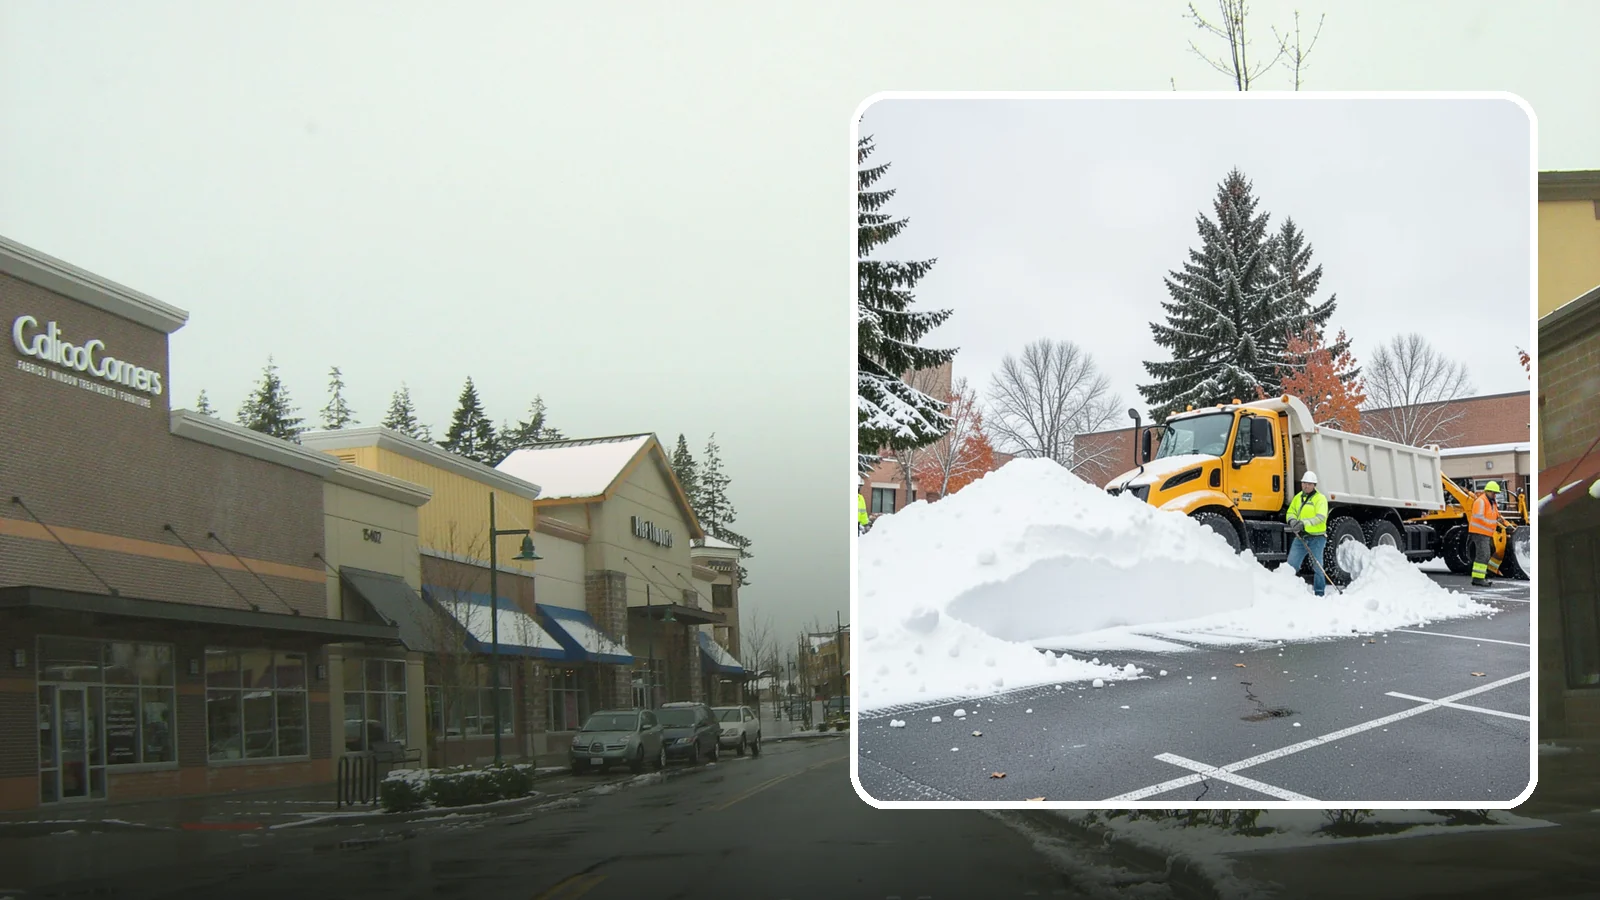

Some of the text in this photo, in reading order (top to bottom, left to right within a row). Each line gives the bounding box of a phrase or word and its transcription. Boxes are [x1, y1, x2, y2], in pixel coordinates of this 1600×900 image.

[17, 360, 47, 377] FABRICS
[51, 370, 78, 387] WINDOW
[78, 378, 117, 398] TREATMENTS
